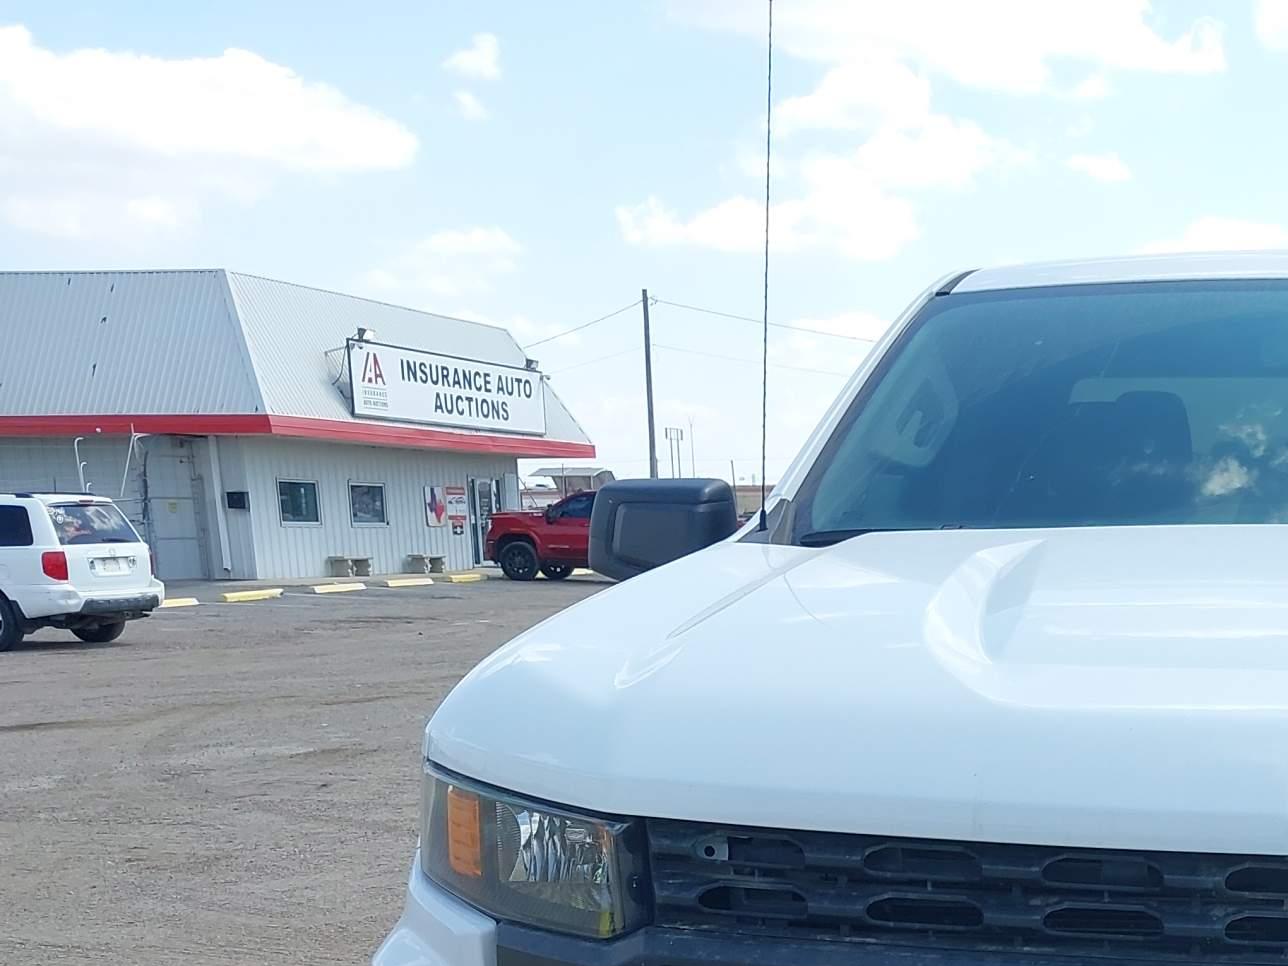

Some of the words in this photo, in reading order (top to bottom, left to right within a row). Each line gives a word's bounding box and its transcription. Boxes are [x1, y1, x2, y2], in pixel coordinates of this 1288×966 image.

[400, 358, 492, 393] INSURANCE
[496, 375, 532, 399] AUTO
[434, 392, 510, 421] AUCTIONS
